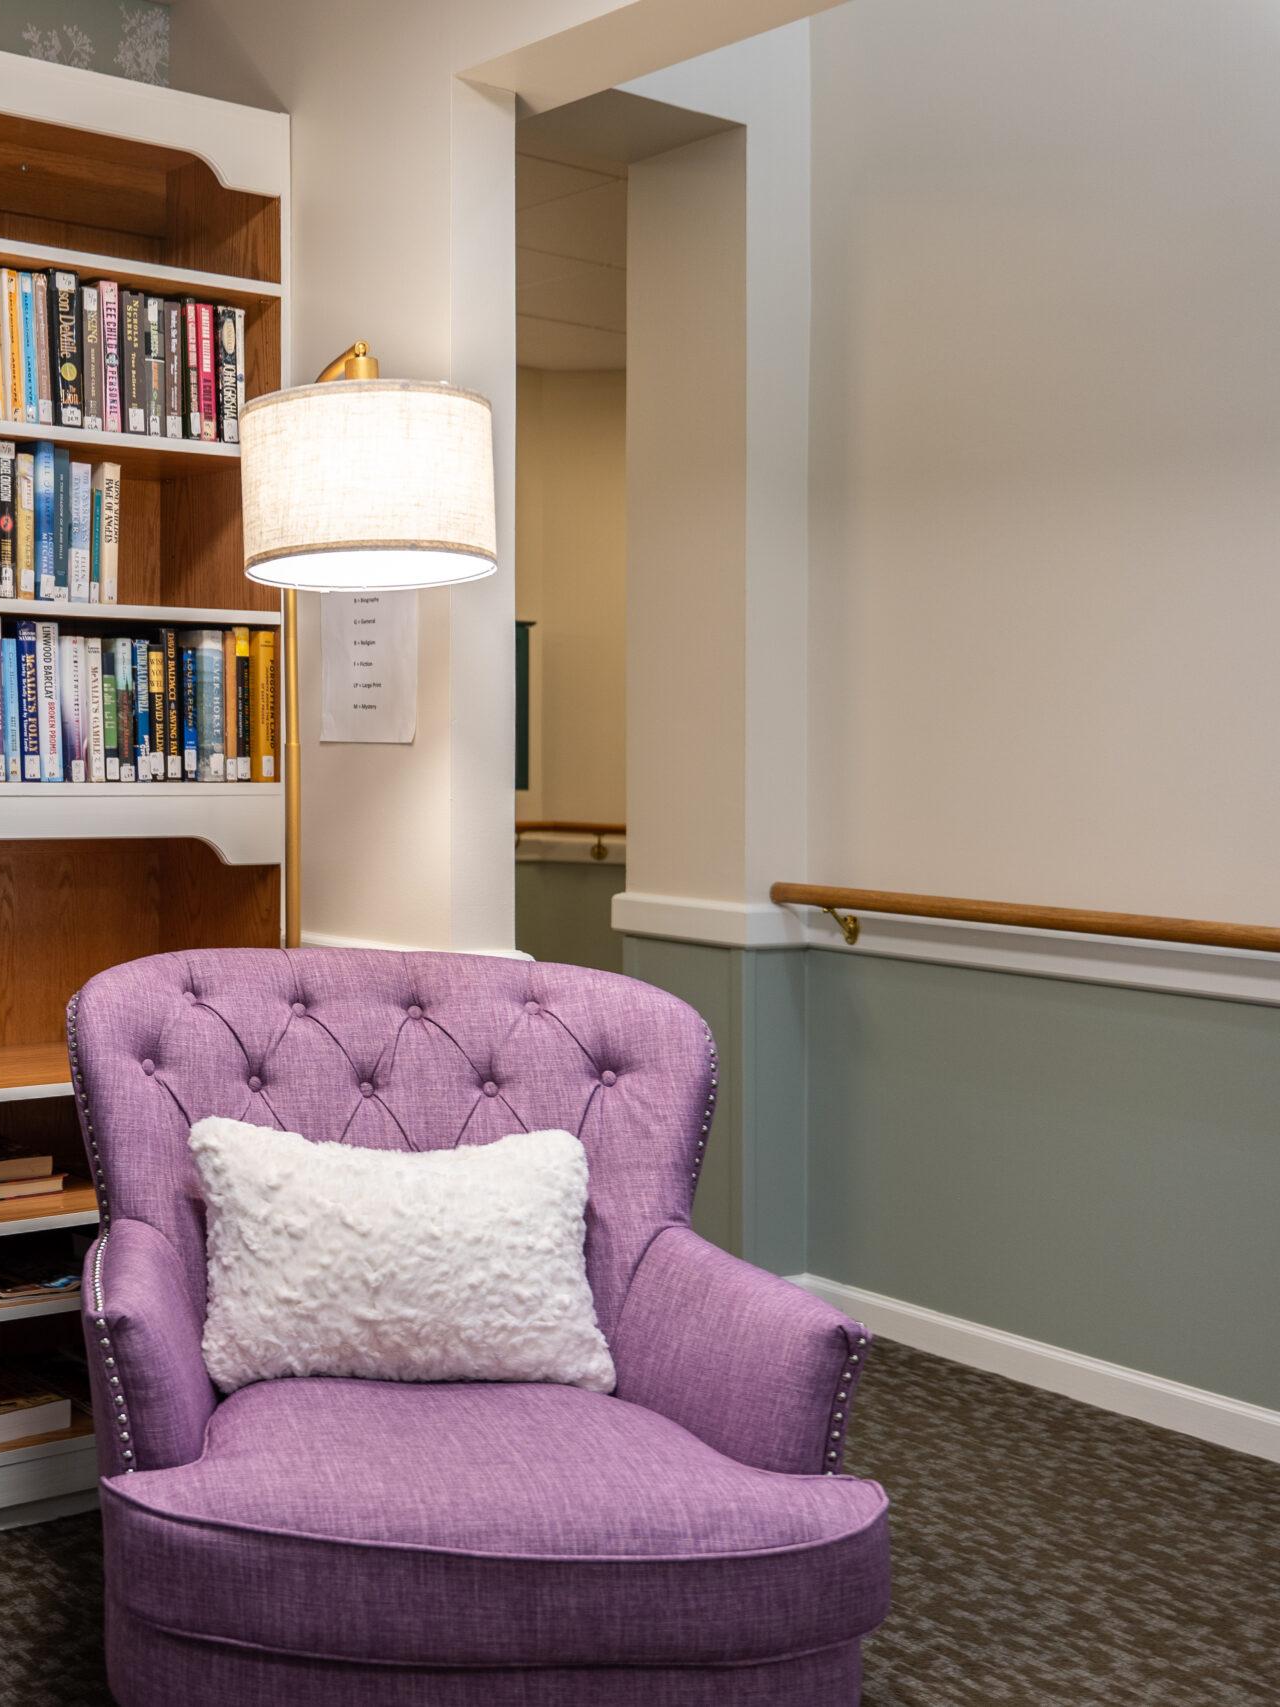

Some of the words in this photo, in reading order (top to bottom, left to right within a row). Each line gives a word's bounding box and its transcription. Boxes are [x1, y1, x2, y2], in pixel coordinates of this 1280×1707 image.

[106, 302, 116, 318] LEE
[107, 321, 117, 348] CHILD
[109, 370, 117, 415] PERSONAL
[105, 479, 113, 500] RAGE
[105, 502, 113, 513] OF
[105, 514, 113, 543] ANGELS
[42, 626, 52, 663] LINWOOD
[44, 665, 53, 699] BARCLAY
[48, 702, 56, 728] BROKEN
